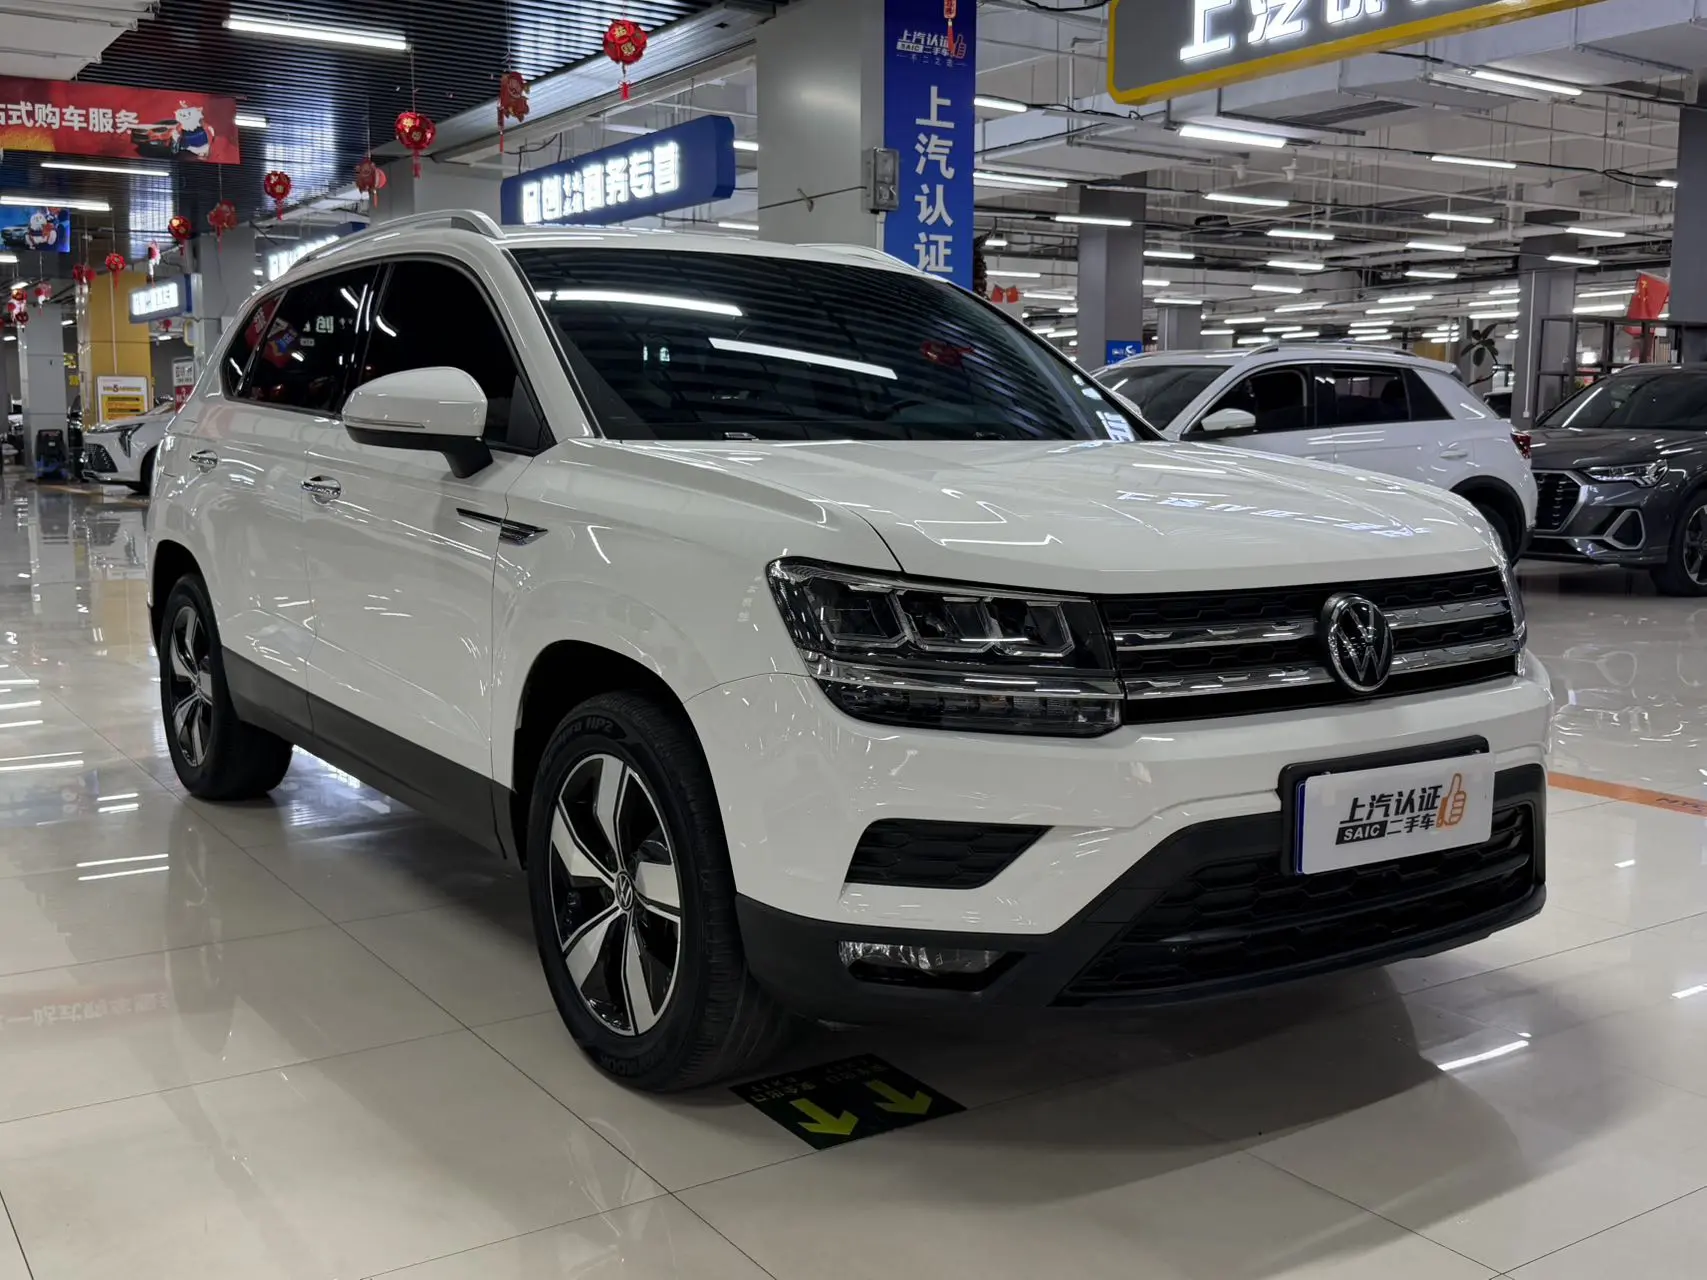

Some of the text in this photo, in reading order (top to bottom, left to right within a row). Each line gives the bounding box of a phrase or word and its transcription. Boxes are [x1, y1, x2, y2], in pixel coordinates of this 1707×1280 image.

[915, 85, 955, 275] 上汽认证
[1340, 785, 1443, 824] 上汽认证
[1343, 824, 1380, 842] SAIC
[1387, 813, 1436, 835] 二手车
